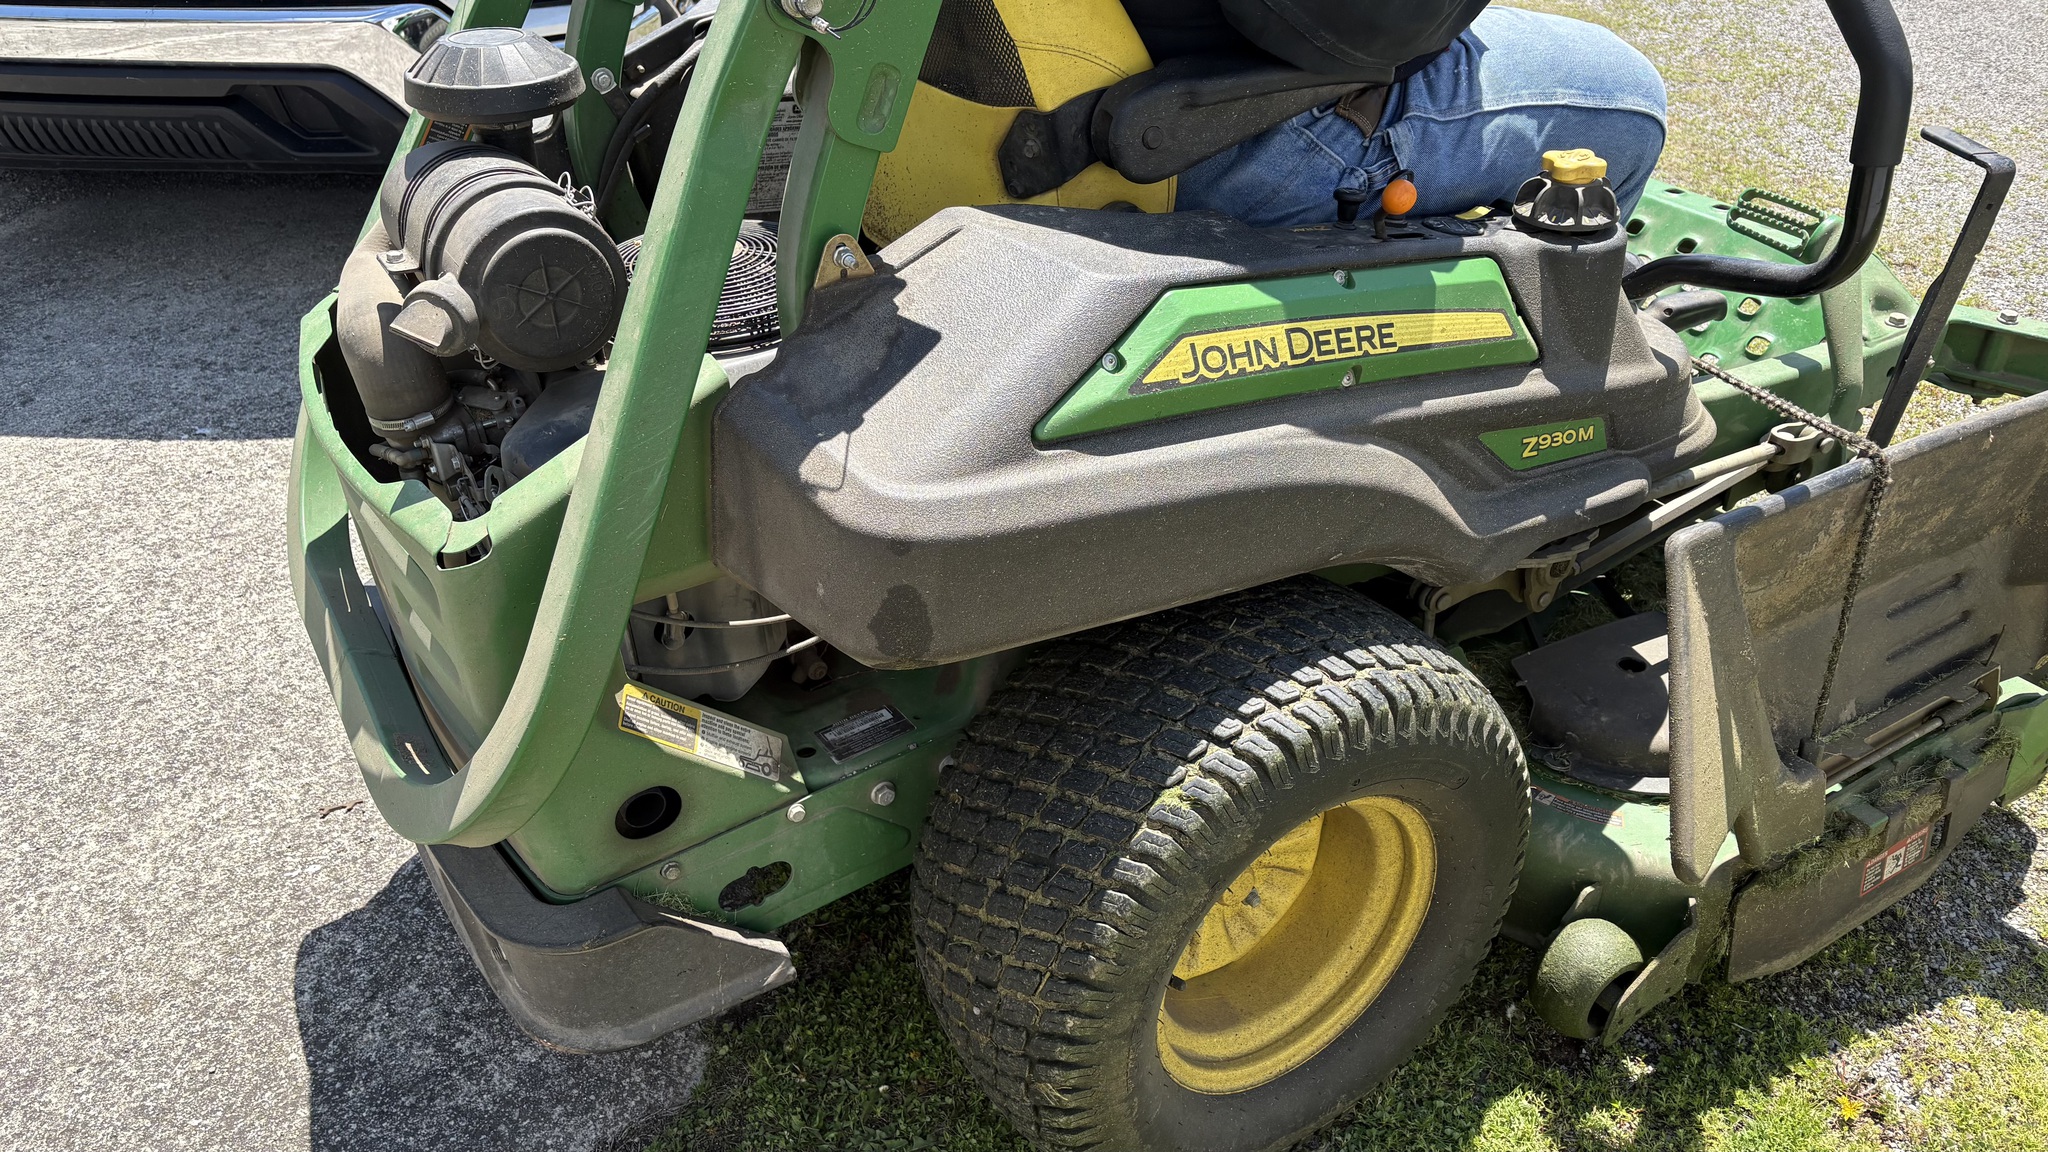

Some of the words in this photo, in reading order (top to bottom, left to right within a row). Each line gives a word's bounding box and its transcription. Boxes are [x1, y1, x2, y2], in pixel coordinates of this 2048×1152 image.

[1182, 336, 1279, 379] JOHN
[1285, 322, 1398, 360] DEERE
[1522, 425, 1594, 458] Z930M
[650, 695, 685, 714] CAUTION
